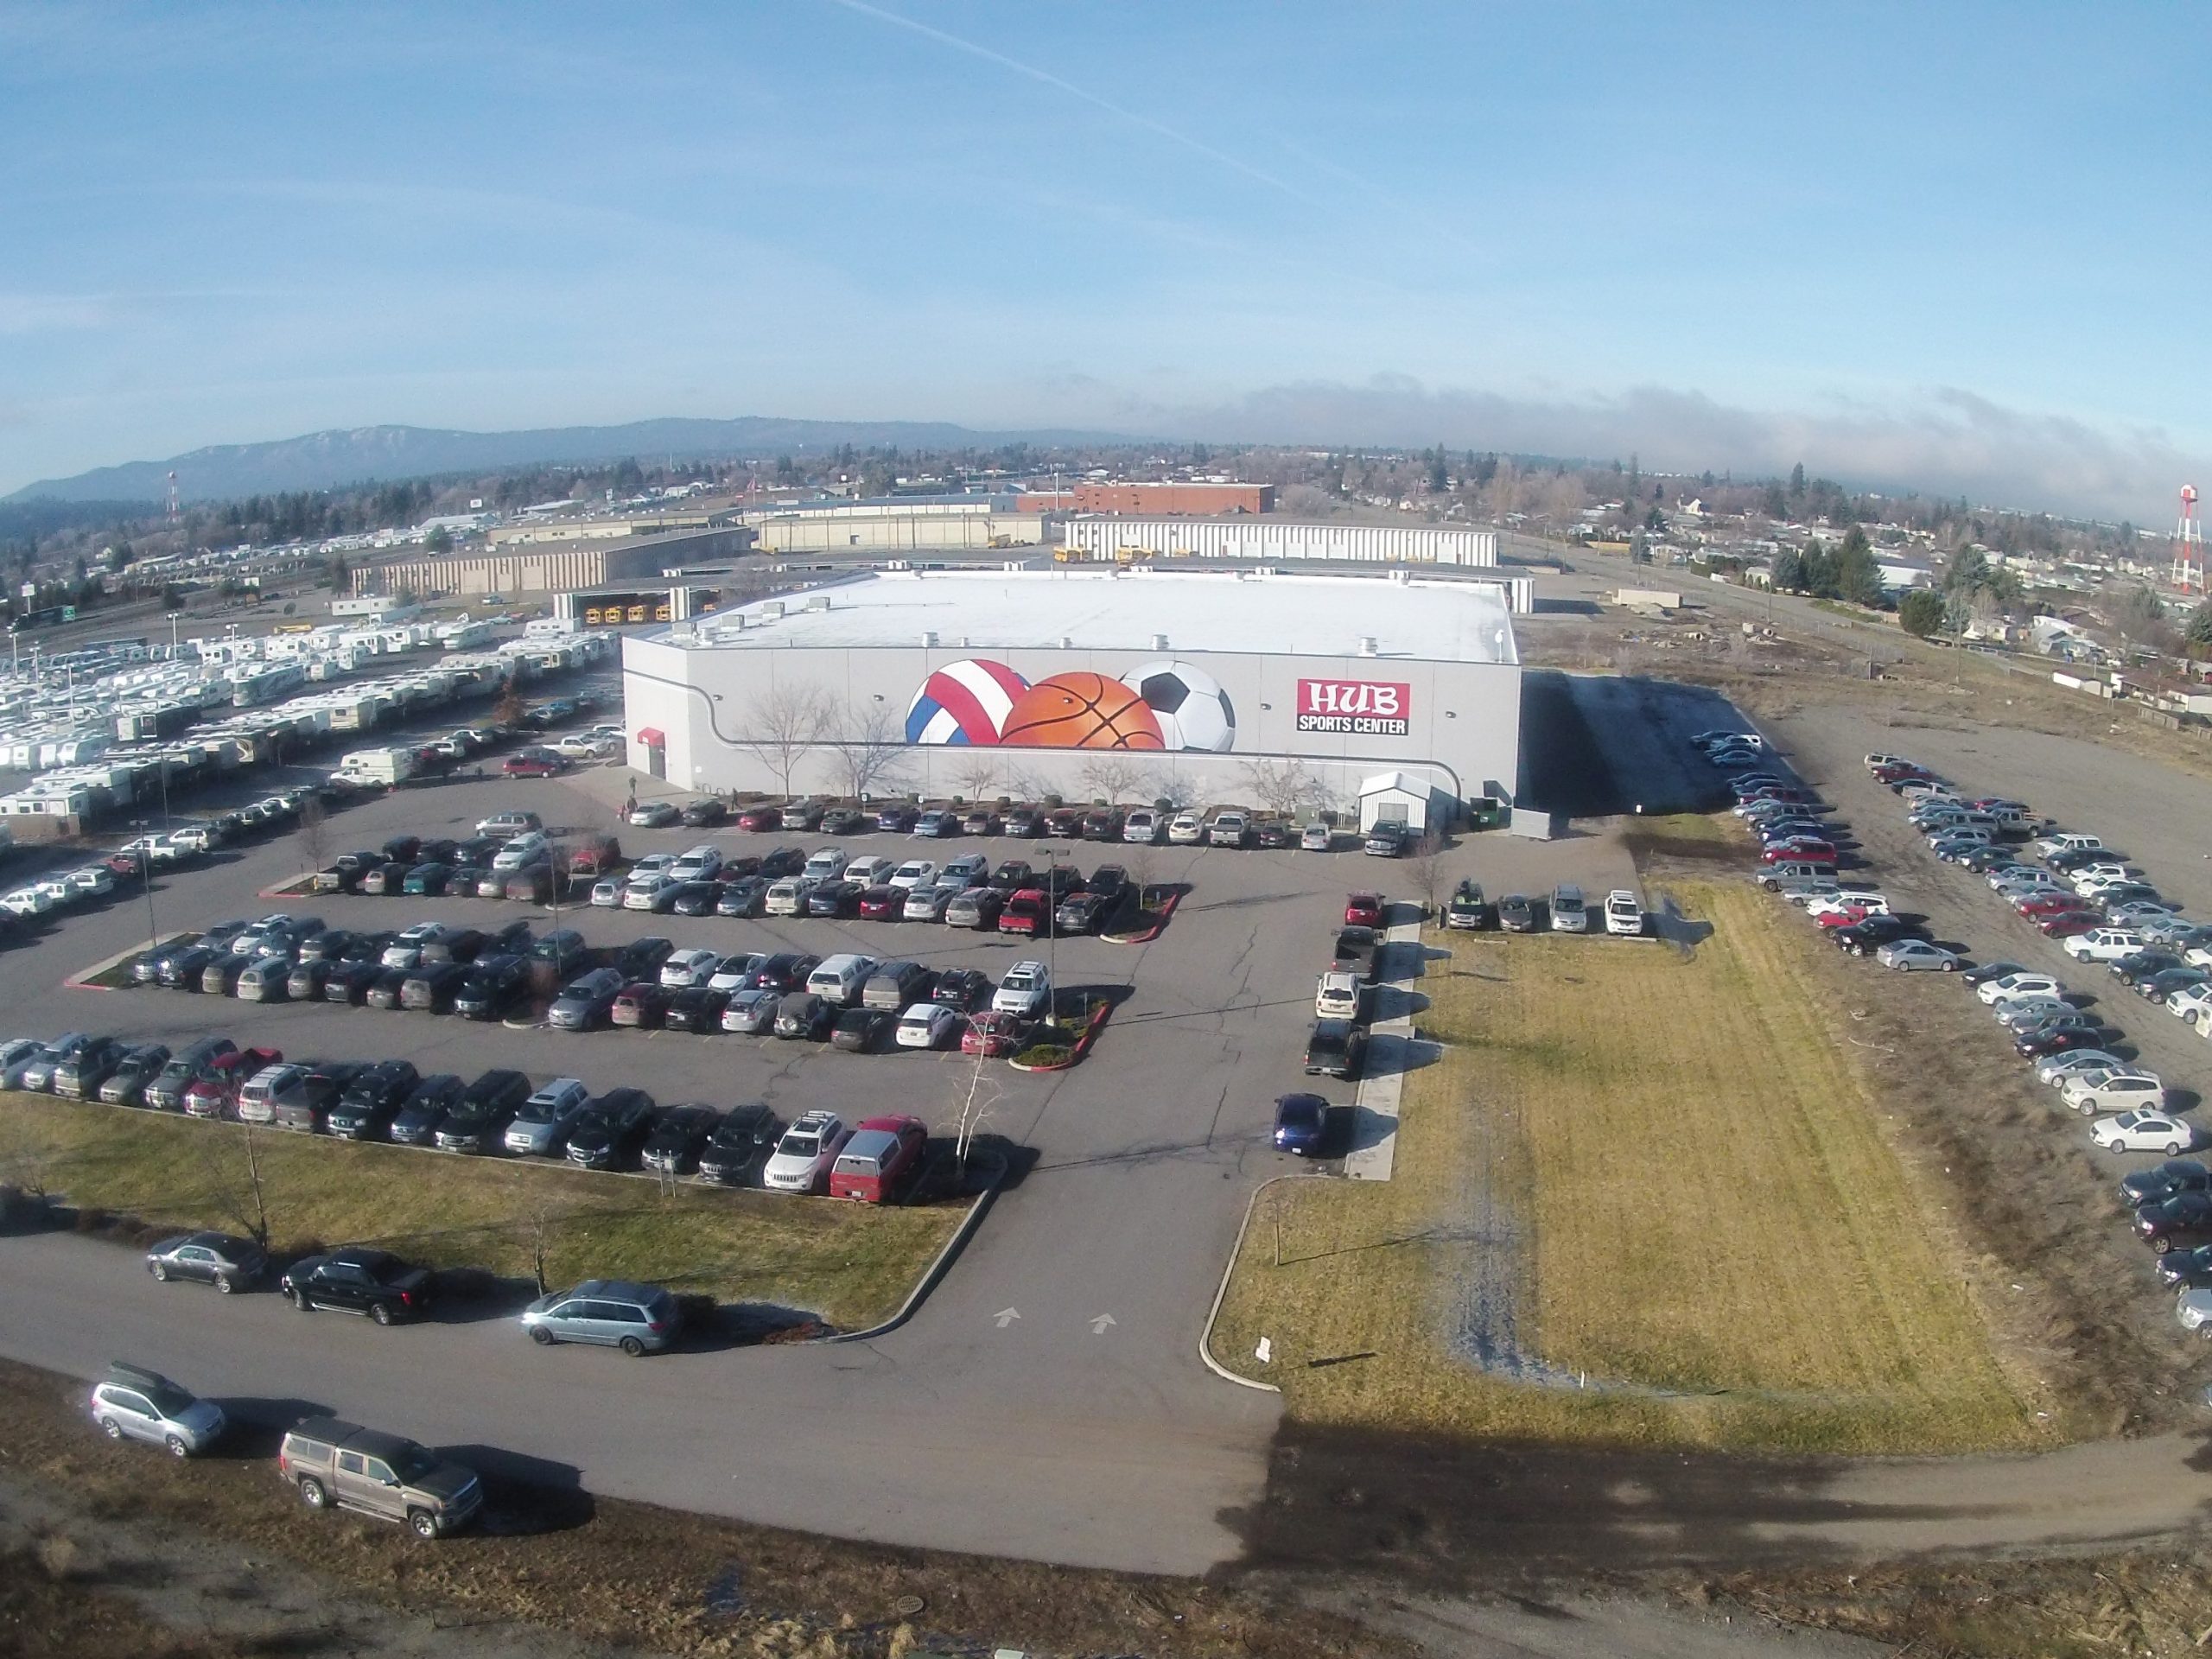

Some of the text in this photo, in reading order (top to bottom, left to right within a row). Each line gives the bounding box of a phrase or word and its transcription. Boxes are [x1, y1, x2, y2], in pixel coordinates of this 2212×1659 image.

[1307, 683, 1399, 715] HUB
[1300, 715, 1406, 734] SPORTS CENTER
